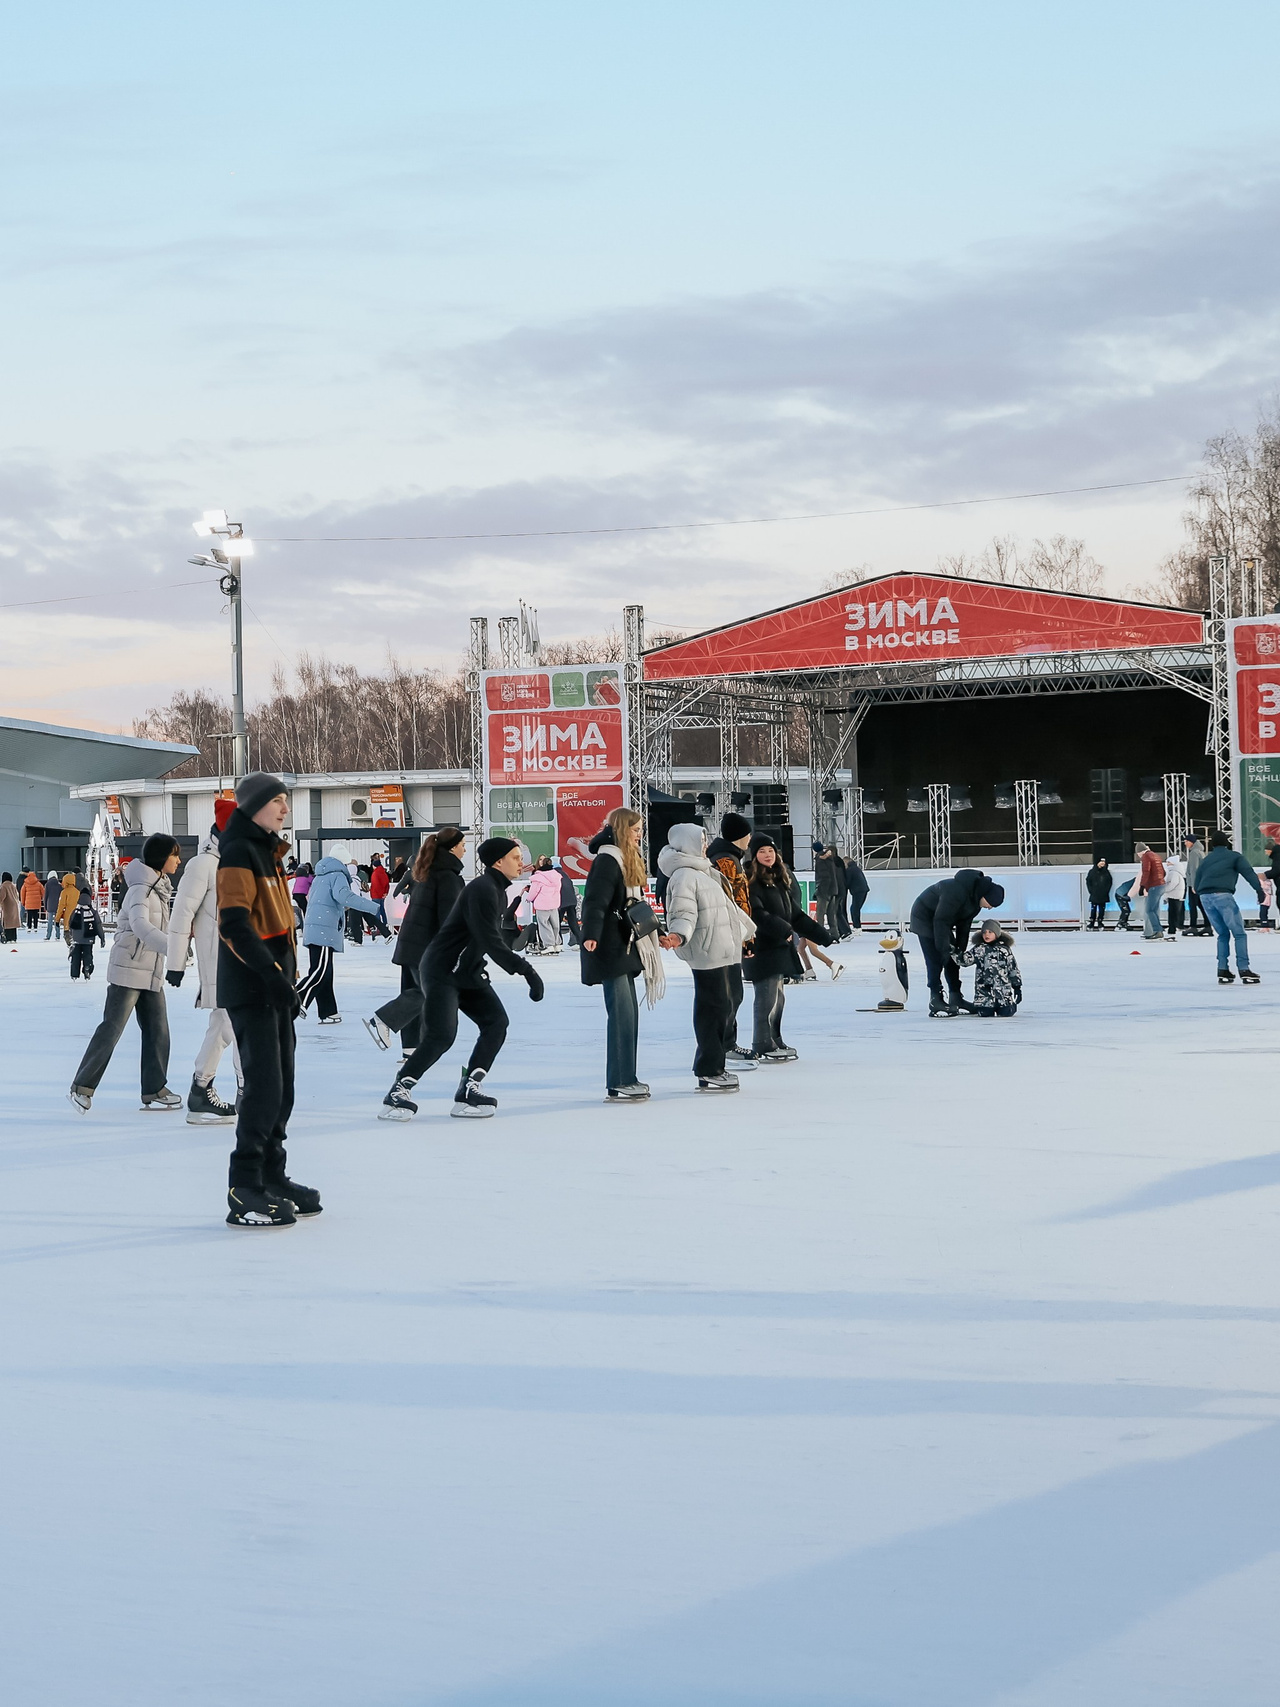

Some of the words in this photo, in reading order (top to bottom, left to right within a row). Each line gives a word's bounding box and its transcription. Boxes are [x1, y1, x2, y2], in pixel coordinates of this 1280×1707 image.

[844, 596, 959, 631] ЗИМА
[845, 635, 859, 651] В
[866, 628, 960, 649] МОСКВЕ
[502, 722, 607, 753] ЗИМА
[1258, 721, 1277, 739] В
[503, 757, 516, 773] В
[522, 754, 608, 772] МОСКВЕ
[1248, 765, 1271, 773] ВСЕ
[88, 923, 94, 931] 2
